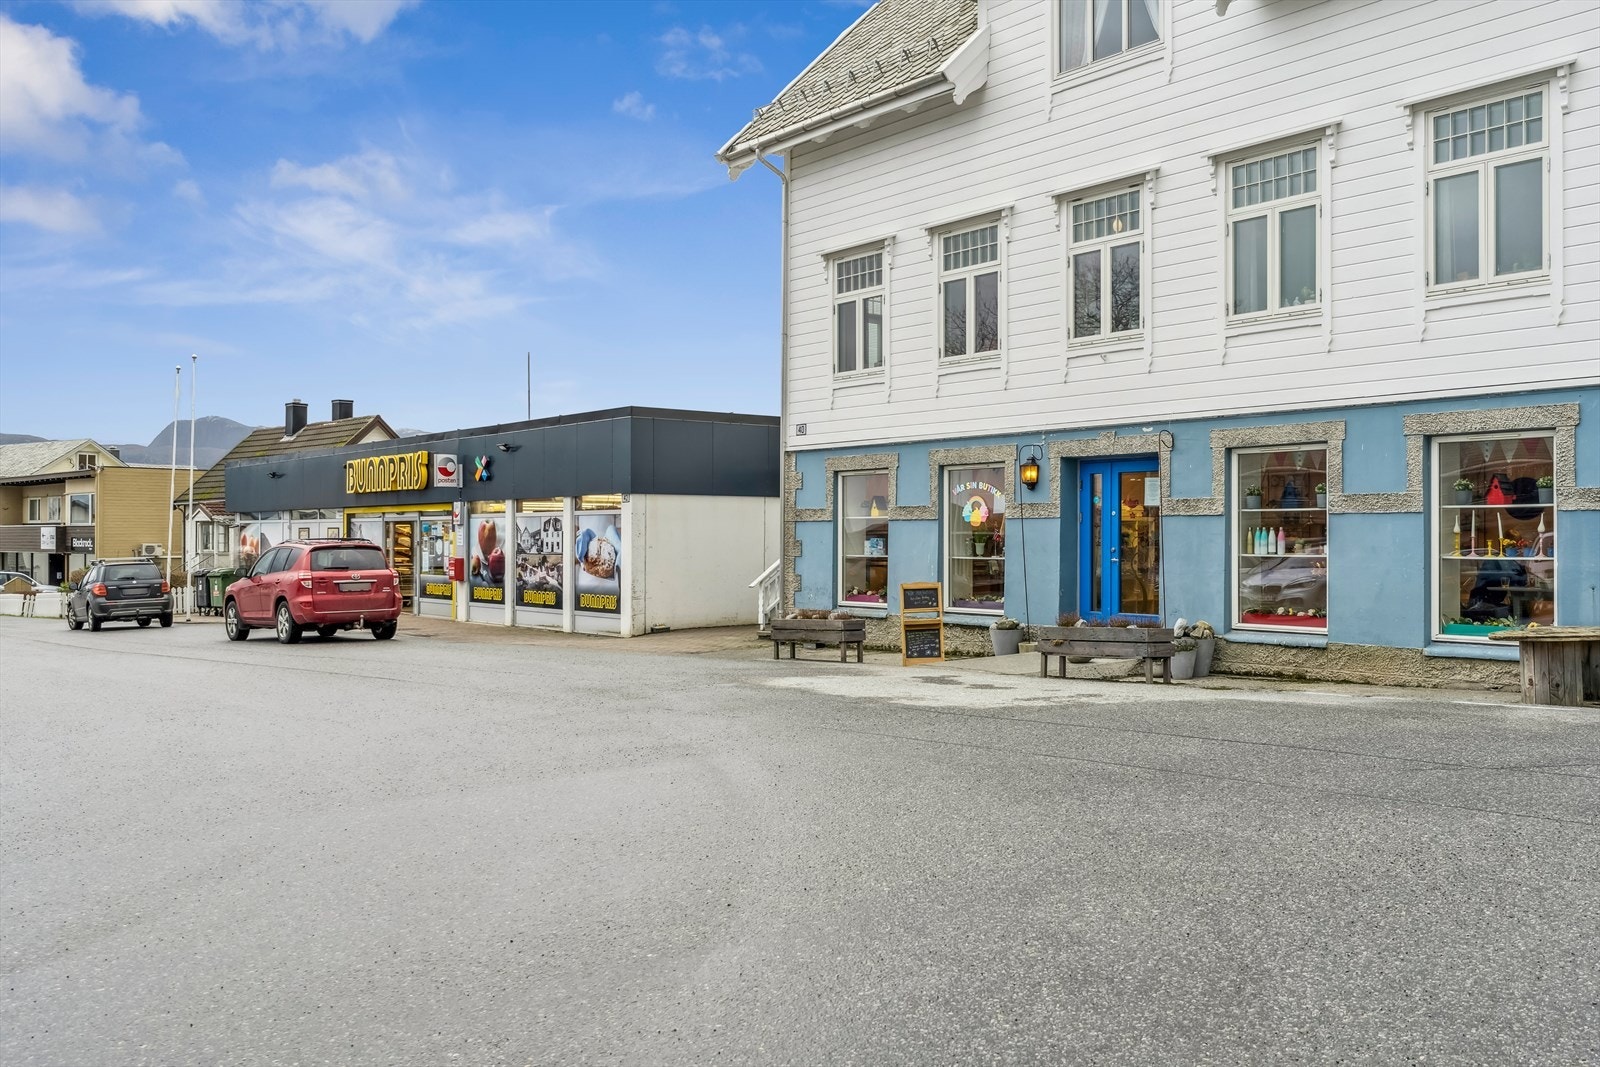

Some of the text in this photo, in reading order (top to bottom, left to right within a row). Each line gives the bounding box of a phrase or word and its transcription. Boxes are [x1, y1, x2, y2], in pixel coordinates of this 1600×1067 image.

[346, 451, 428, 494] BUNNPRIS
[966, 481, 978, 490] SIN
[473, 586, 502, 601] BUNNPRIS
[523, 589, 556, 606] BUNNPRIS
[579, 593, 618, 610] BUNNPRIS
